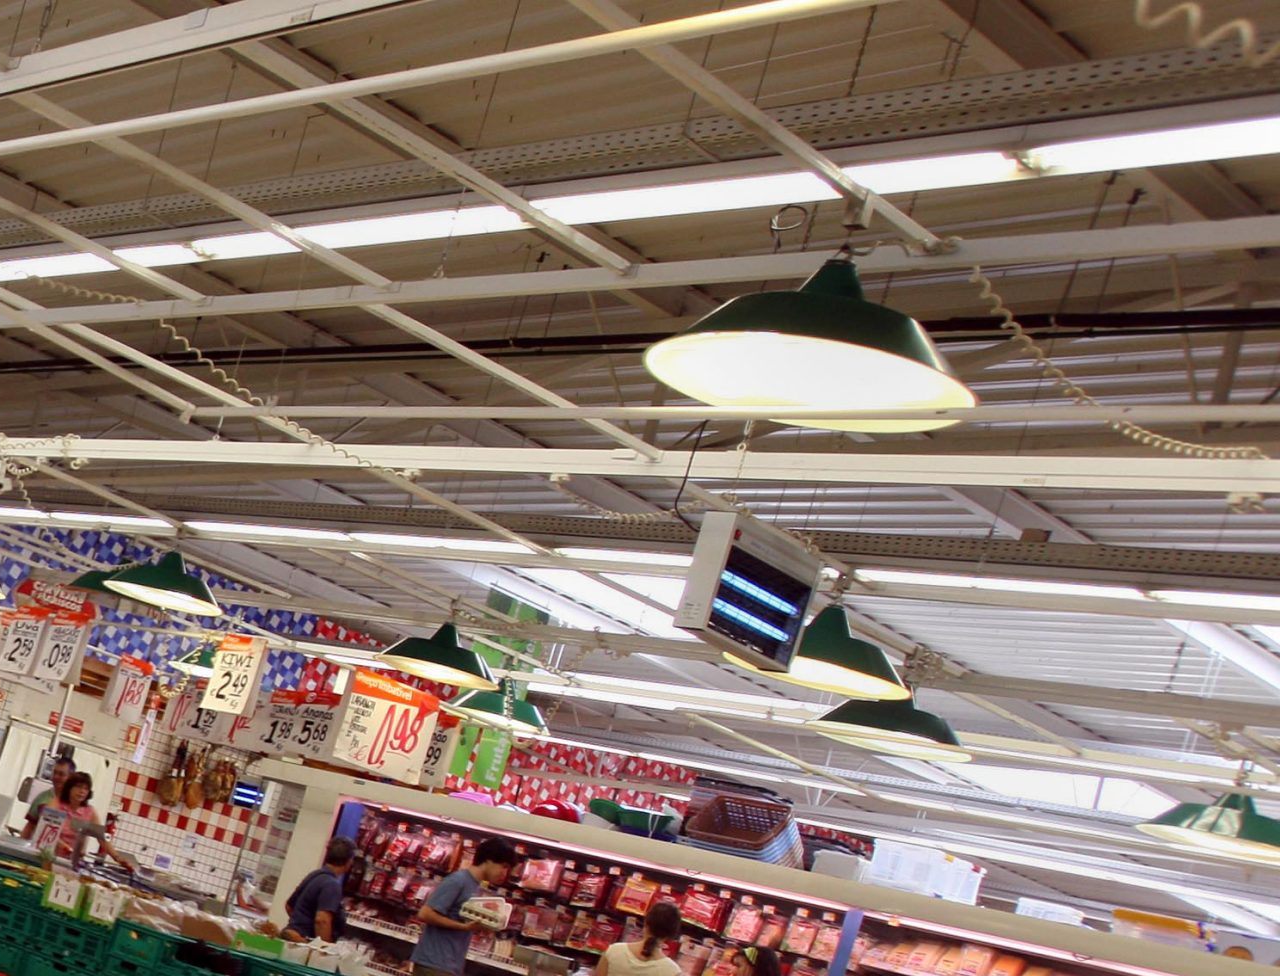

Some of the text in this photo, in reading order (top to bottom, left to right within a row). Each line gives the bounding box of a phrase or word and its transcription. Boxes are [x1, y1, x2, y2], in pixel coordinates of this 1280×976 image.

[15, 620, 40, 632] Uva
[221, 653, 255, 668] KIWI
[302, 707, 334, 721] Ananas
[485, 732, 510, 783] Fruta
